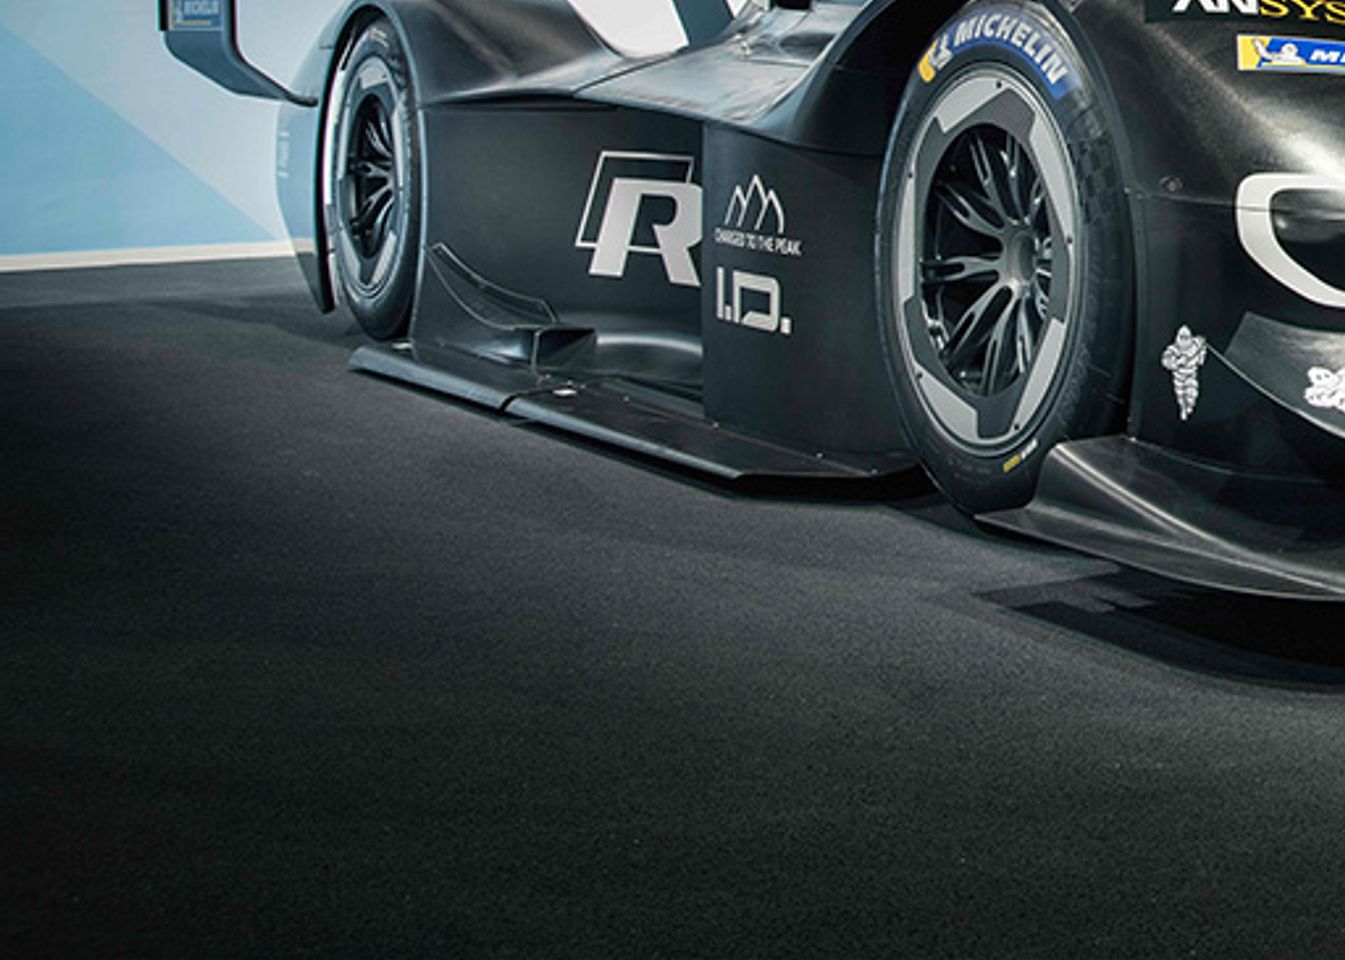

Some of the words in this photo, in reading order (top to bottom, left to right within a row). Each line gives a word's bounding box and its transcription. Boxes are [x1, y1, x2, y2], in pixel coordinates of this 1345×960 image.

[953, 13, 1069, 85] MICHELIN
[587, 177, 703, 287] R
[716, 266, 792, 336] I.D.
